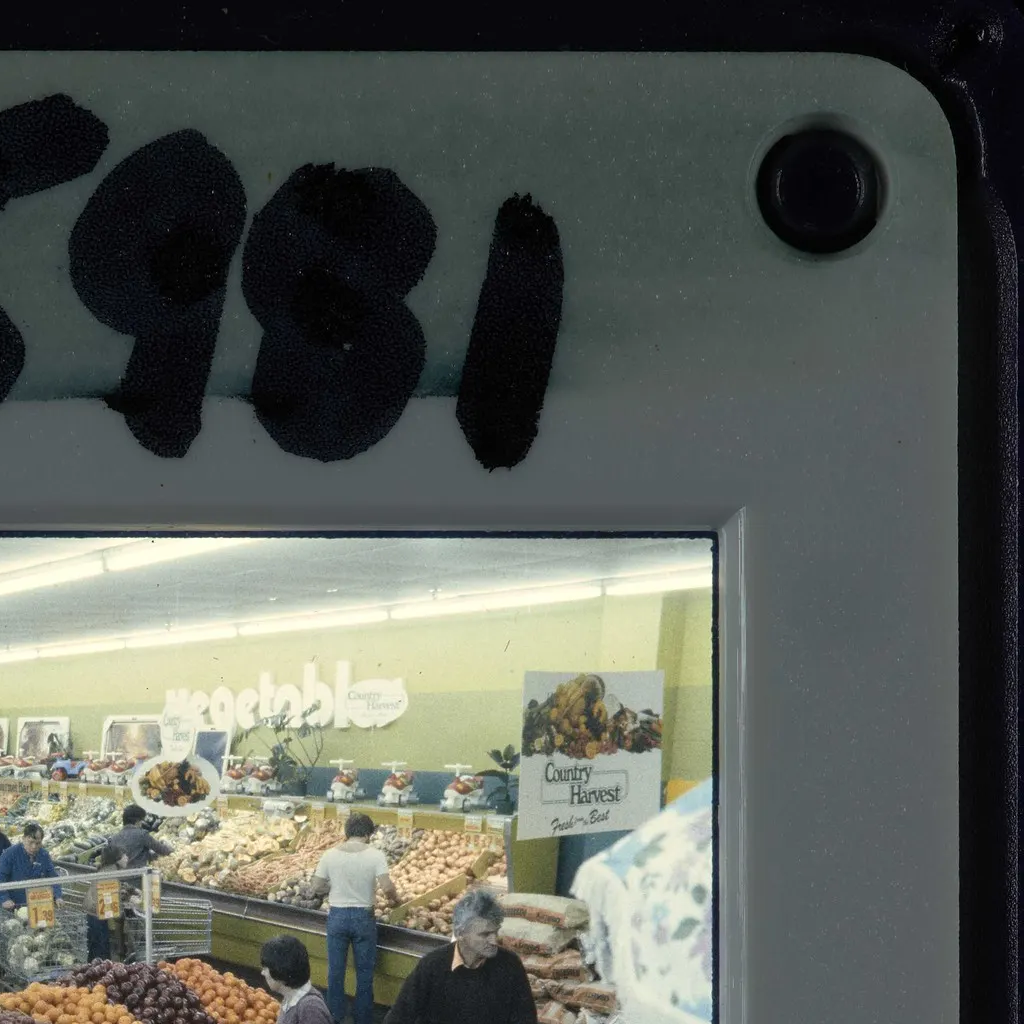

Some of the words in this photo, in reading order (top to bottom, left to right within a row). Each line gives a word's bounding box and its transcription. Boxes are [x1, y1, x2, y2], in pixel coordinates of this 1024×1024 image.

[545, 762, 593, 784] Country
[570, 784, 621, 805] Harvest
[550, 815, 574, 835] Fresh
[589, 808, 610, 825] Best
